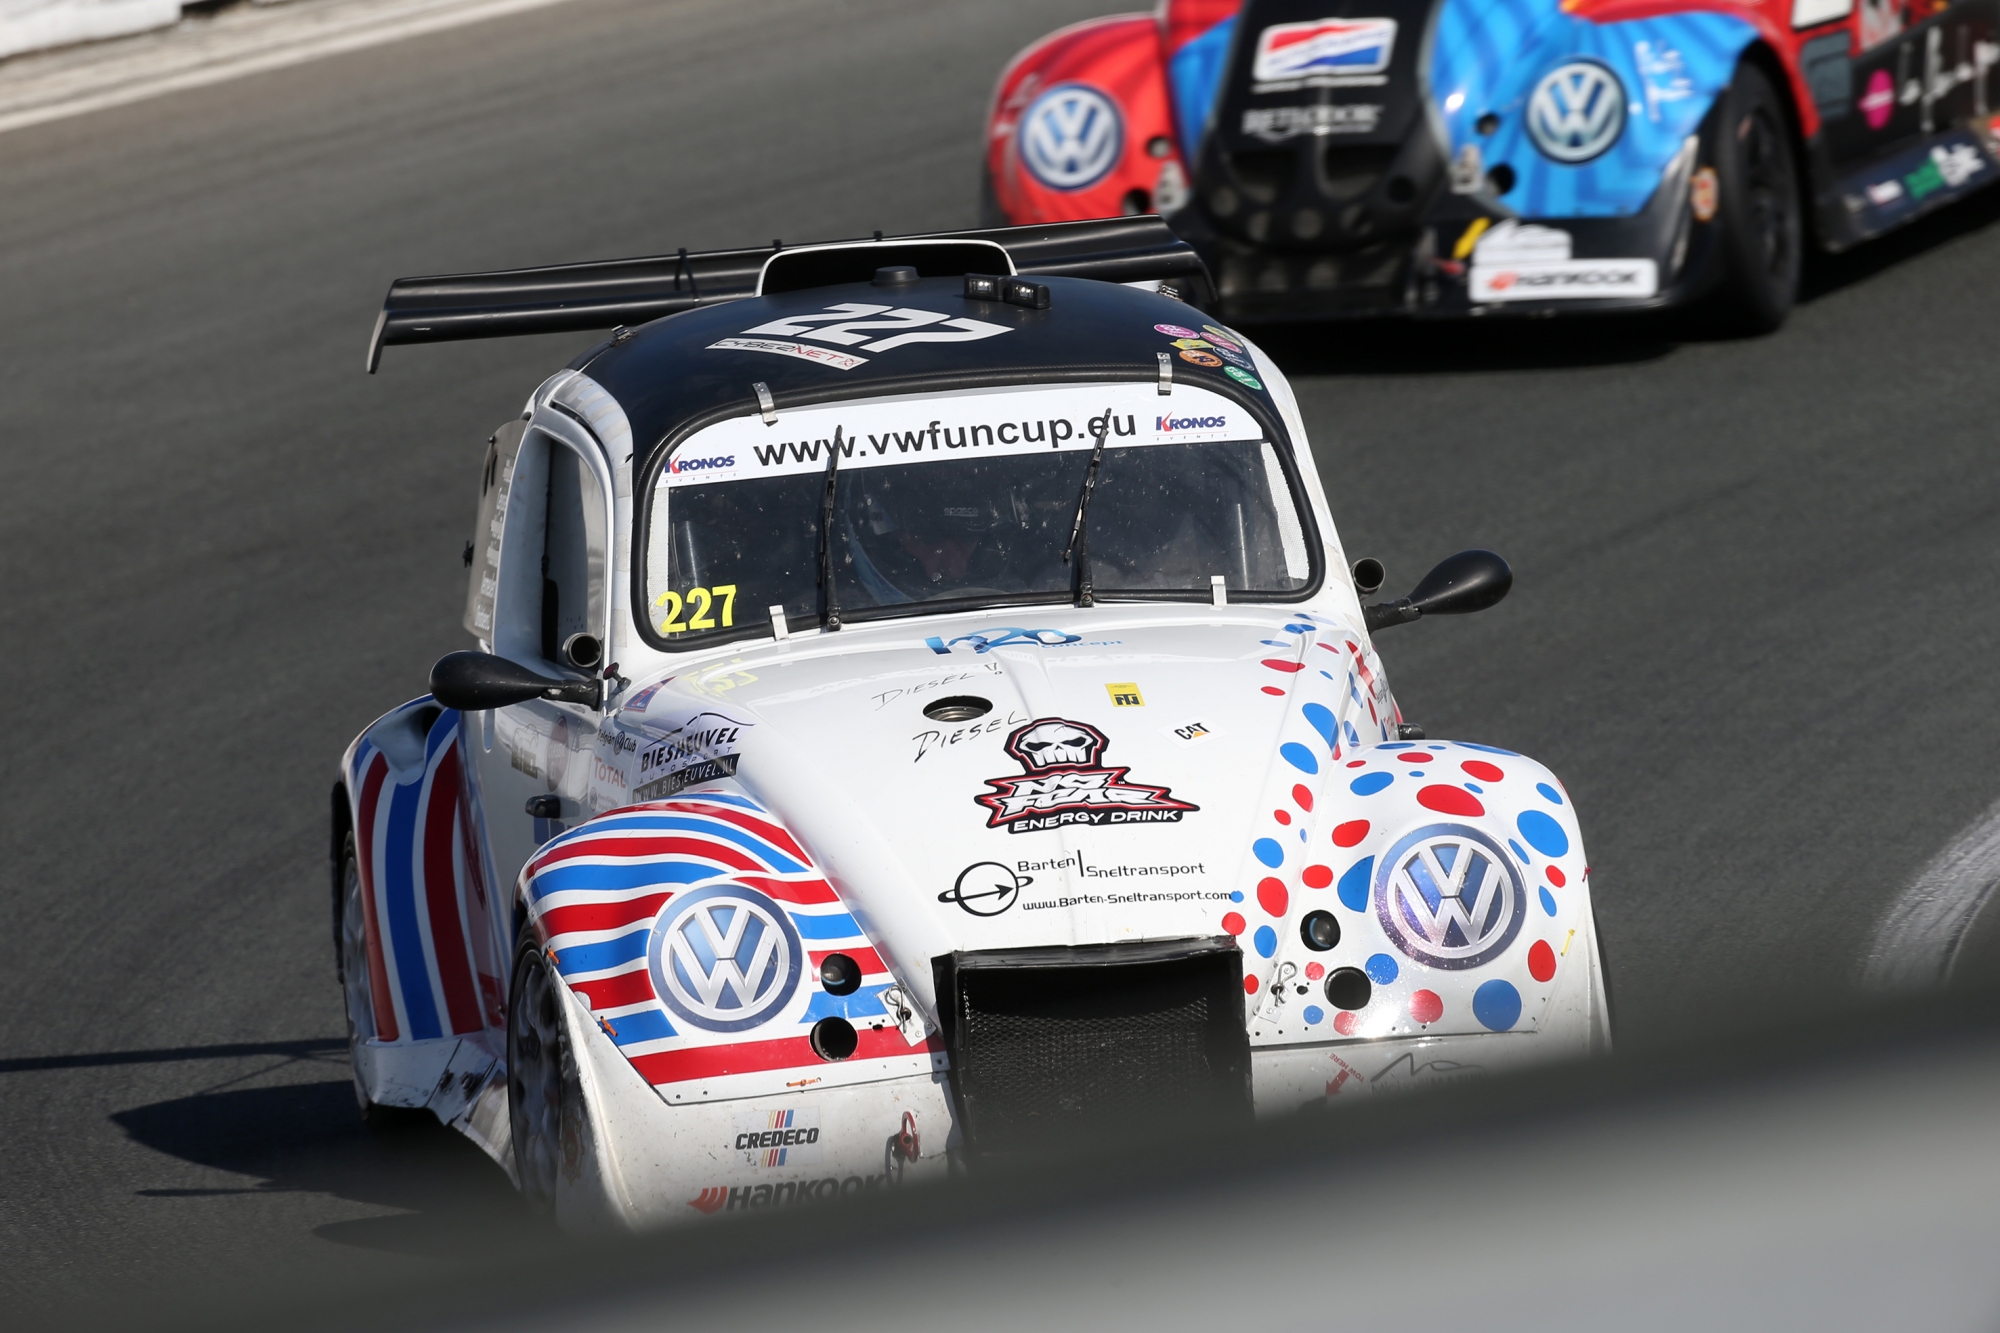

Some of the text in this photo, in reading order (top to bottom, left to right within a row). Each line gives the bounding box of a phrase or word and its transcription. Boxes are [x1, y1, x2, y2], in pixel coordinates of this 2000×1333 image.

[740, 303, 1015, 353] 227
[1156, 411, 1226, 432] KRONOS
[754, 413, 1136, 467] www.vwfuncup.eu
[664, 454, 735, 474] KRONOS
[665, 473, 737, 484] EVENTS
[656, 585, 737, 633] 227
[871, 672, 975, 711] DIESEL
[624, 734, 637, 753] Club
[912, 711, 1027, 763] DIESEL
[1174, 722, 1211, 740] CAT
[641, 728, 740, 773] BIESHEUVEL
[594, 757, 627, 788] TOTAL
[639, 746, 733, 785] AUTOSPORT
[635, 761, 734, 801] WWW.BIESEUVEL.NL
[999, 789, 1166, 817] FEAR
[1013, 810, 1179, 832] ENERGY DRINK
[1017, 857, 1206, 878] Barten Sneltransport
[1022, 890, 1232, 911] www.Barten-Sneltransport.com
[1329, 1052, 1365, 1083] TOW HERE
[735, 1127, 819, 1150] CREDECO
